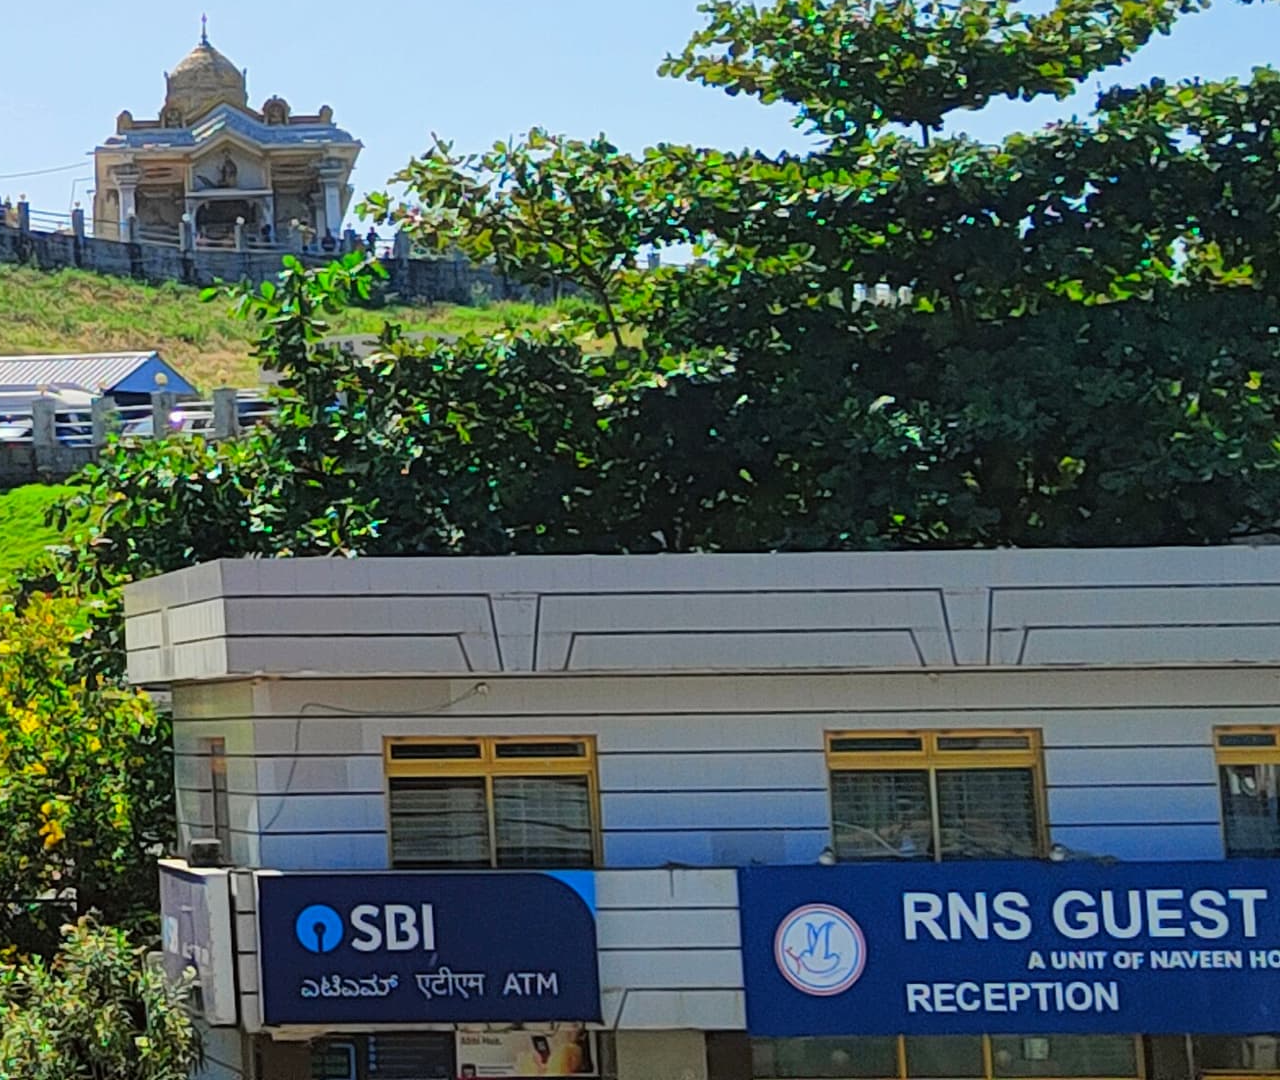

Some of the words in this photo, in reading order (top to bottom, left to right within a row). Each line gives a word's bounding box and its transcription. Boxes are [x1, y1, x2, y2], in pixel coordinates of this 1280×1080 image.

[350, 903, 435, 952] SBI
[903, 891, 1032, 941] RNS
[1052, 889, 1267, 939] GUEST
[1028, 951, 1046, 970] A
[1050, 951, 1108, 970] UNIT
[1113, 951, 1144, 970] OF
[1150, 950, 1242, 969] NAVEEN
[415, 966, 486, 999] एटीएम
[502, 972, 559, 995] ATM
[906, 981, 1120, 1013] RECEPTION
